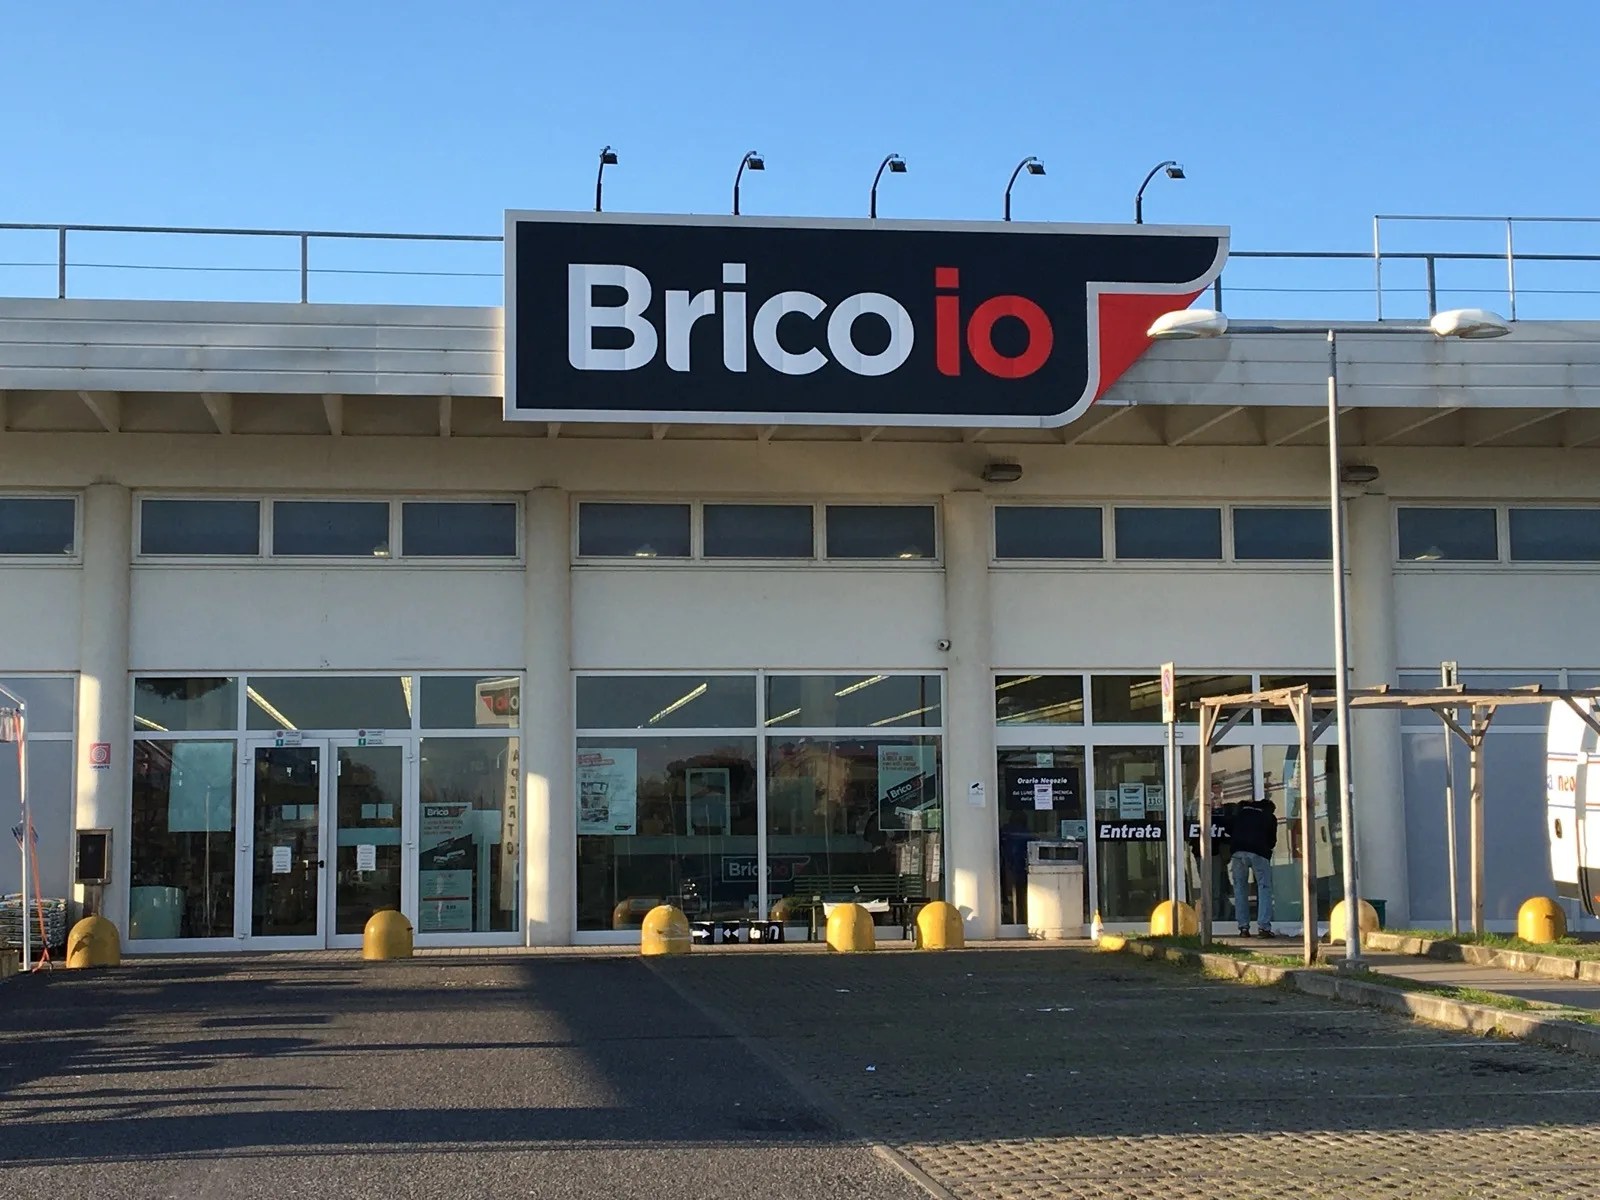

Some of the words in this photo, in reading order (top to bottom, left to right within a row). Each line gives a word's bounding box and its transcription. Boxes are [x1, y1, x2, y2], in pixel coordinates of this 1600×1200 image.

[568, 263, 914, 376] Brico
[935, 267, 1053, 379] io
[889, 783, 912, 799] Brico
[427, 807, 449, 816] Brico
[1099, 824, 1162, 839] Entrata
